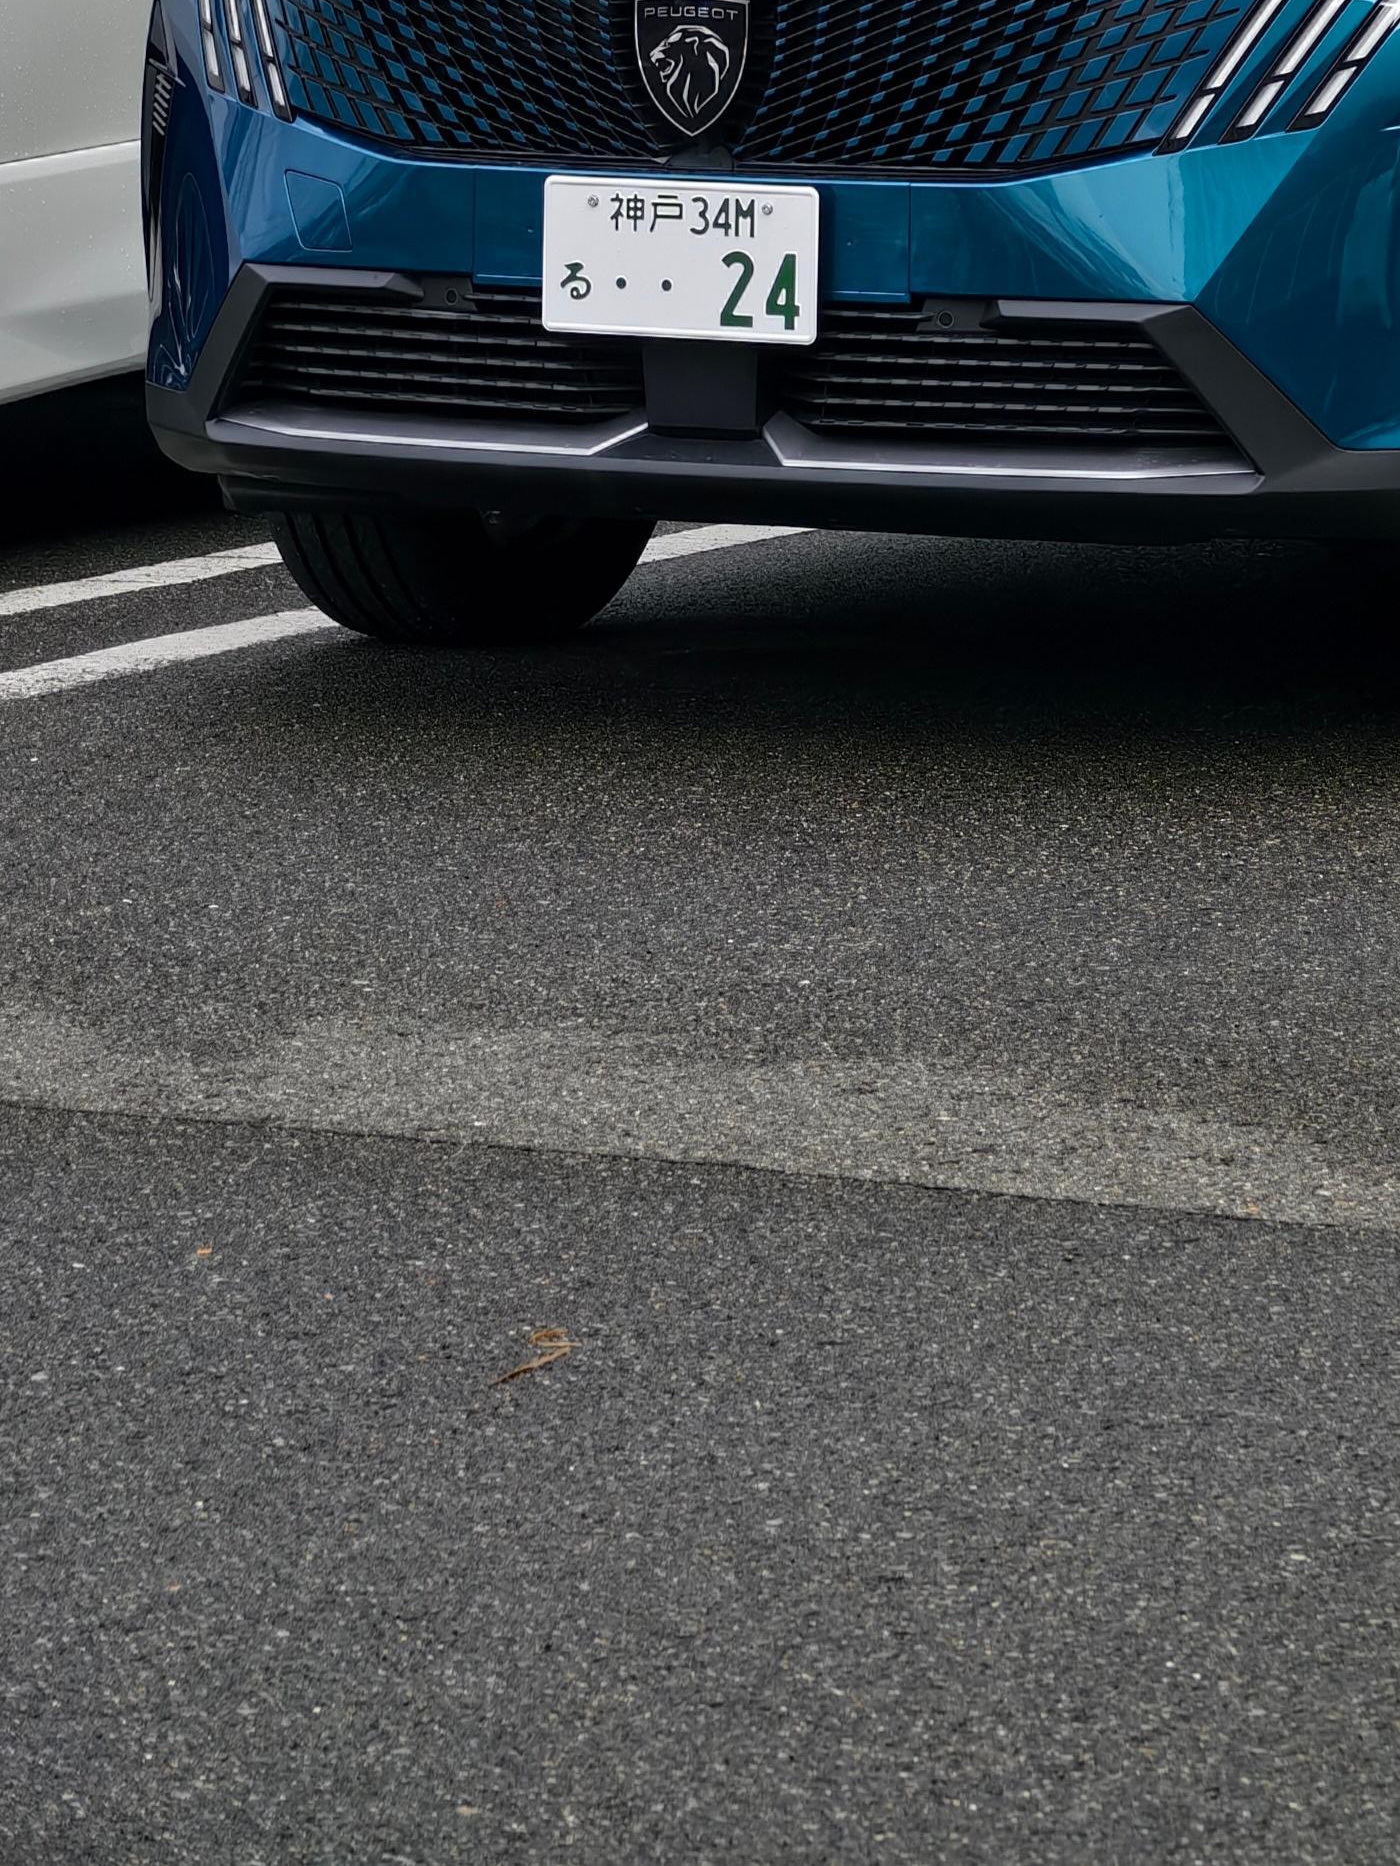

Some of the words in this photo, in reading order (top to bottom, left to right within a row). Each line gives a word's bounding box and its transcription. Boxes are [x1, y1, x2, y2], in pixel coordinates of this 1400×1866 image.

[644, 6, 739, 21] PEUGEOT
[560, 262, 592, 300] る
[719, 251, 801, 331] 24
